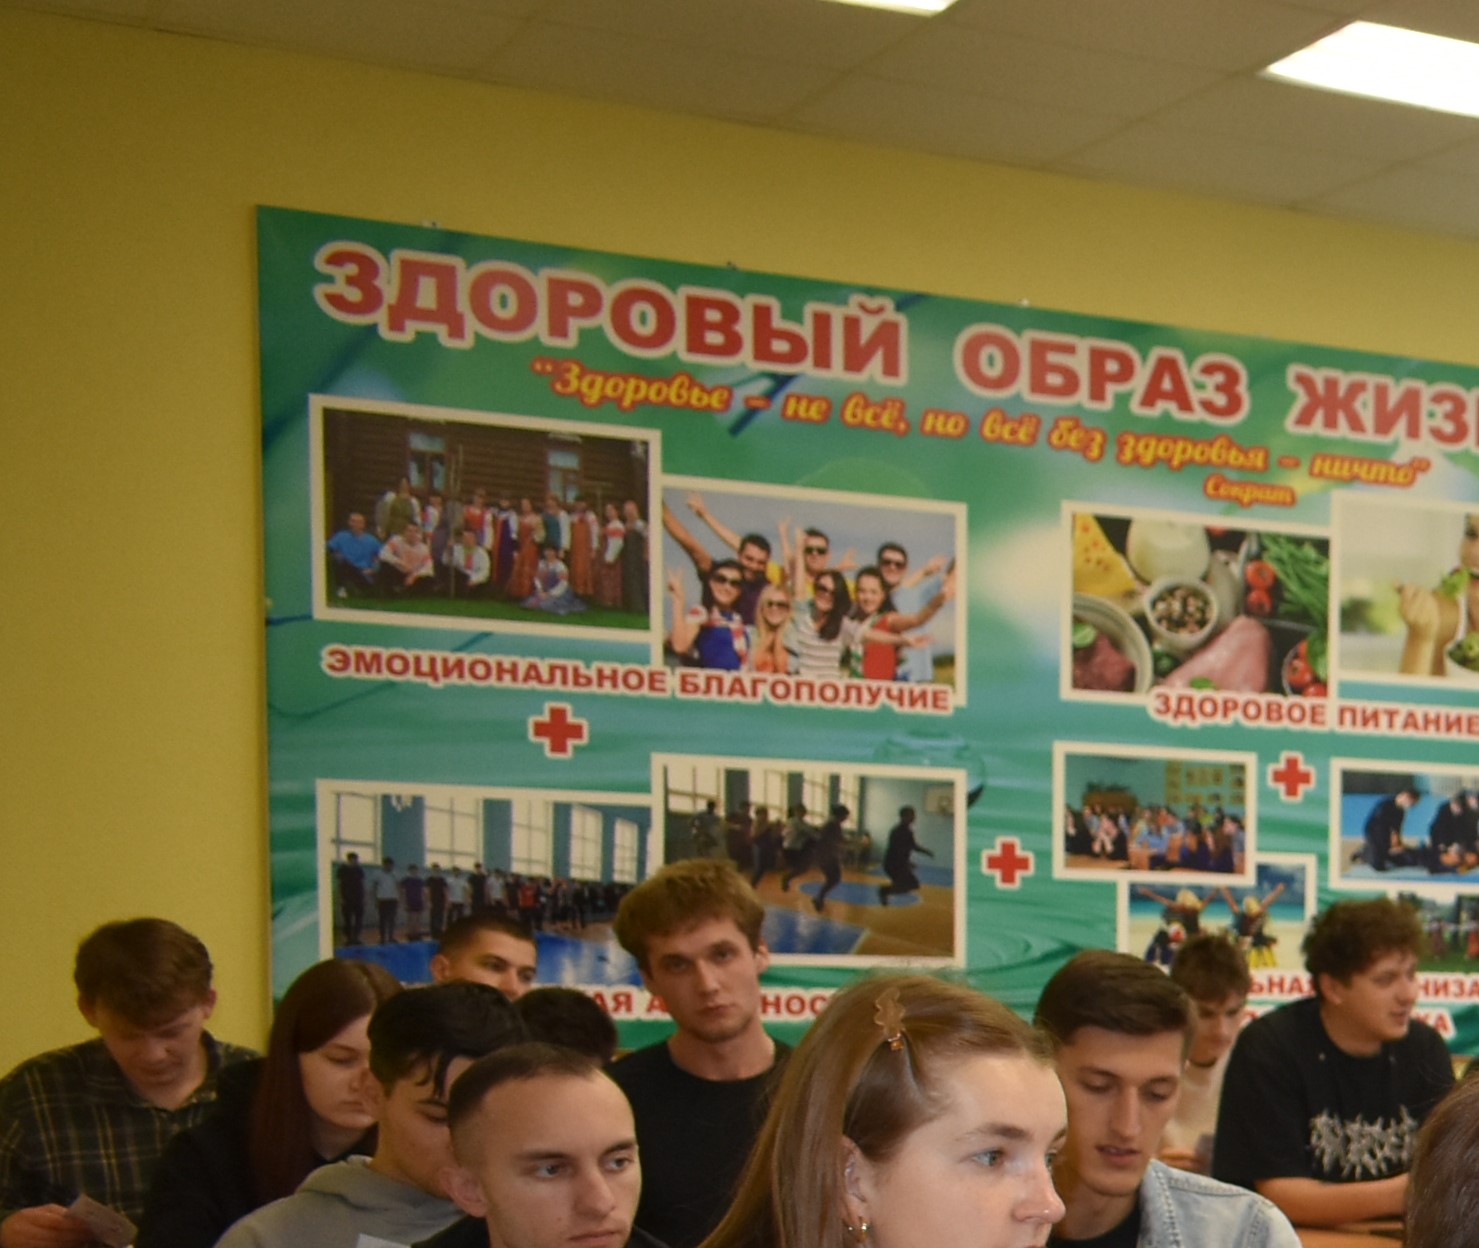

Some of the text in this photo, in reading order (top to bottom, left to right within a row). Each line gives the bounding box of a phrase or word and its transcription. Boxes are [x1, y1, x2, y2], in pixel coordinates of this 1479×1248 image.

[315, 246, 905, 381] ЗДОРОВЫЙ
[959, 329, 1248, 421] ОБРАЗ
[783, 394, 829, 422] не
[921, 411, 967, 437] но
[981, 410, 1036, 445] всё
[1049, 415, 1106, 459] без
[1117, 429, 1267, 473] здоровья
[1203, 475, 1296, 508] Сократ
[324, 648, 950, 713] ЭМОЦИОНАЛЬНОЕ БЛАГОПОЛУЧИЕ
[1153, 693, 1327, 727] ЗДОРОВОЕ
